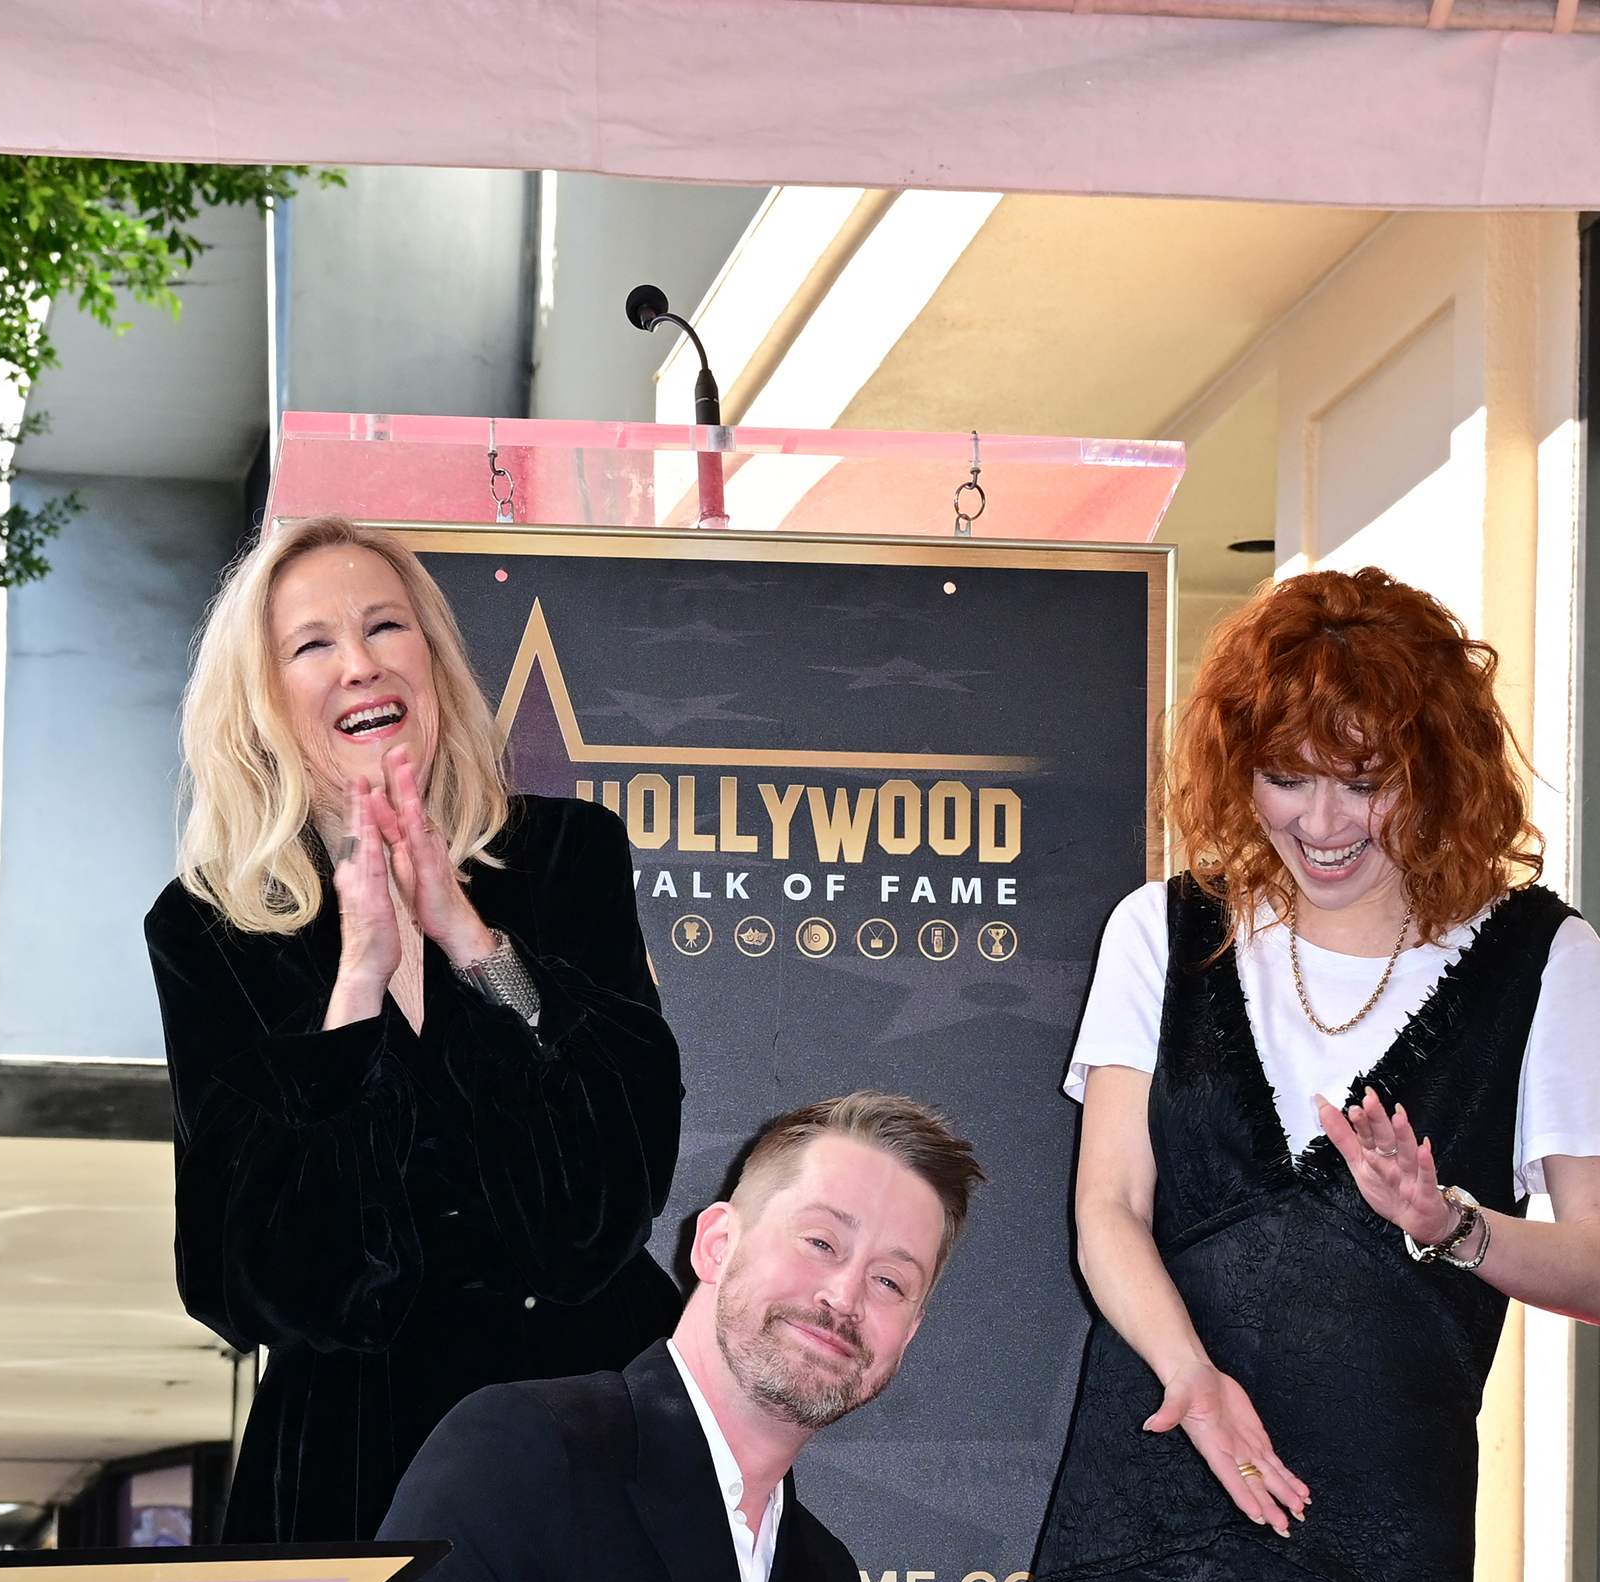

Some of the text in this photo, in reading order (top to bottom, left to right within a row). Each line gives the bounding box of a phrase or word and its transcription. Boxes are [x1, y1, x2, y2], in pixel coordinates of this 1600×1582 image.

[632, 869, 1017, 905] ALK OF FAME
